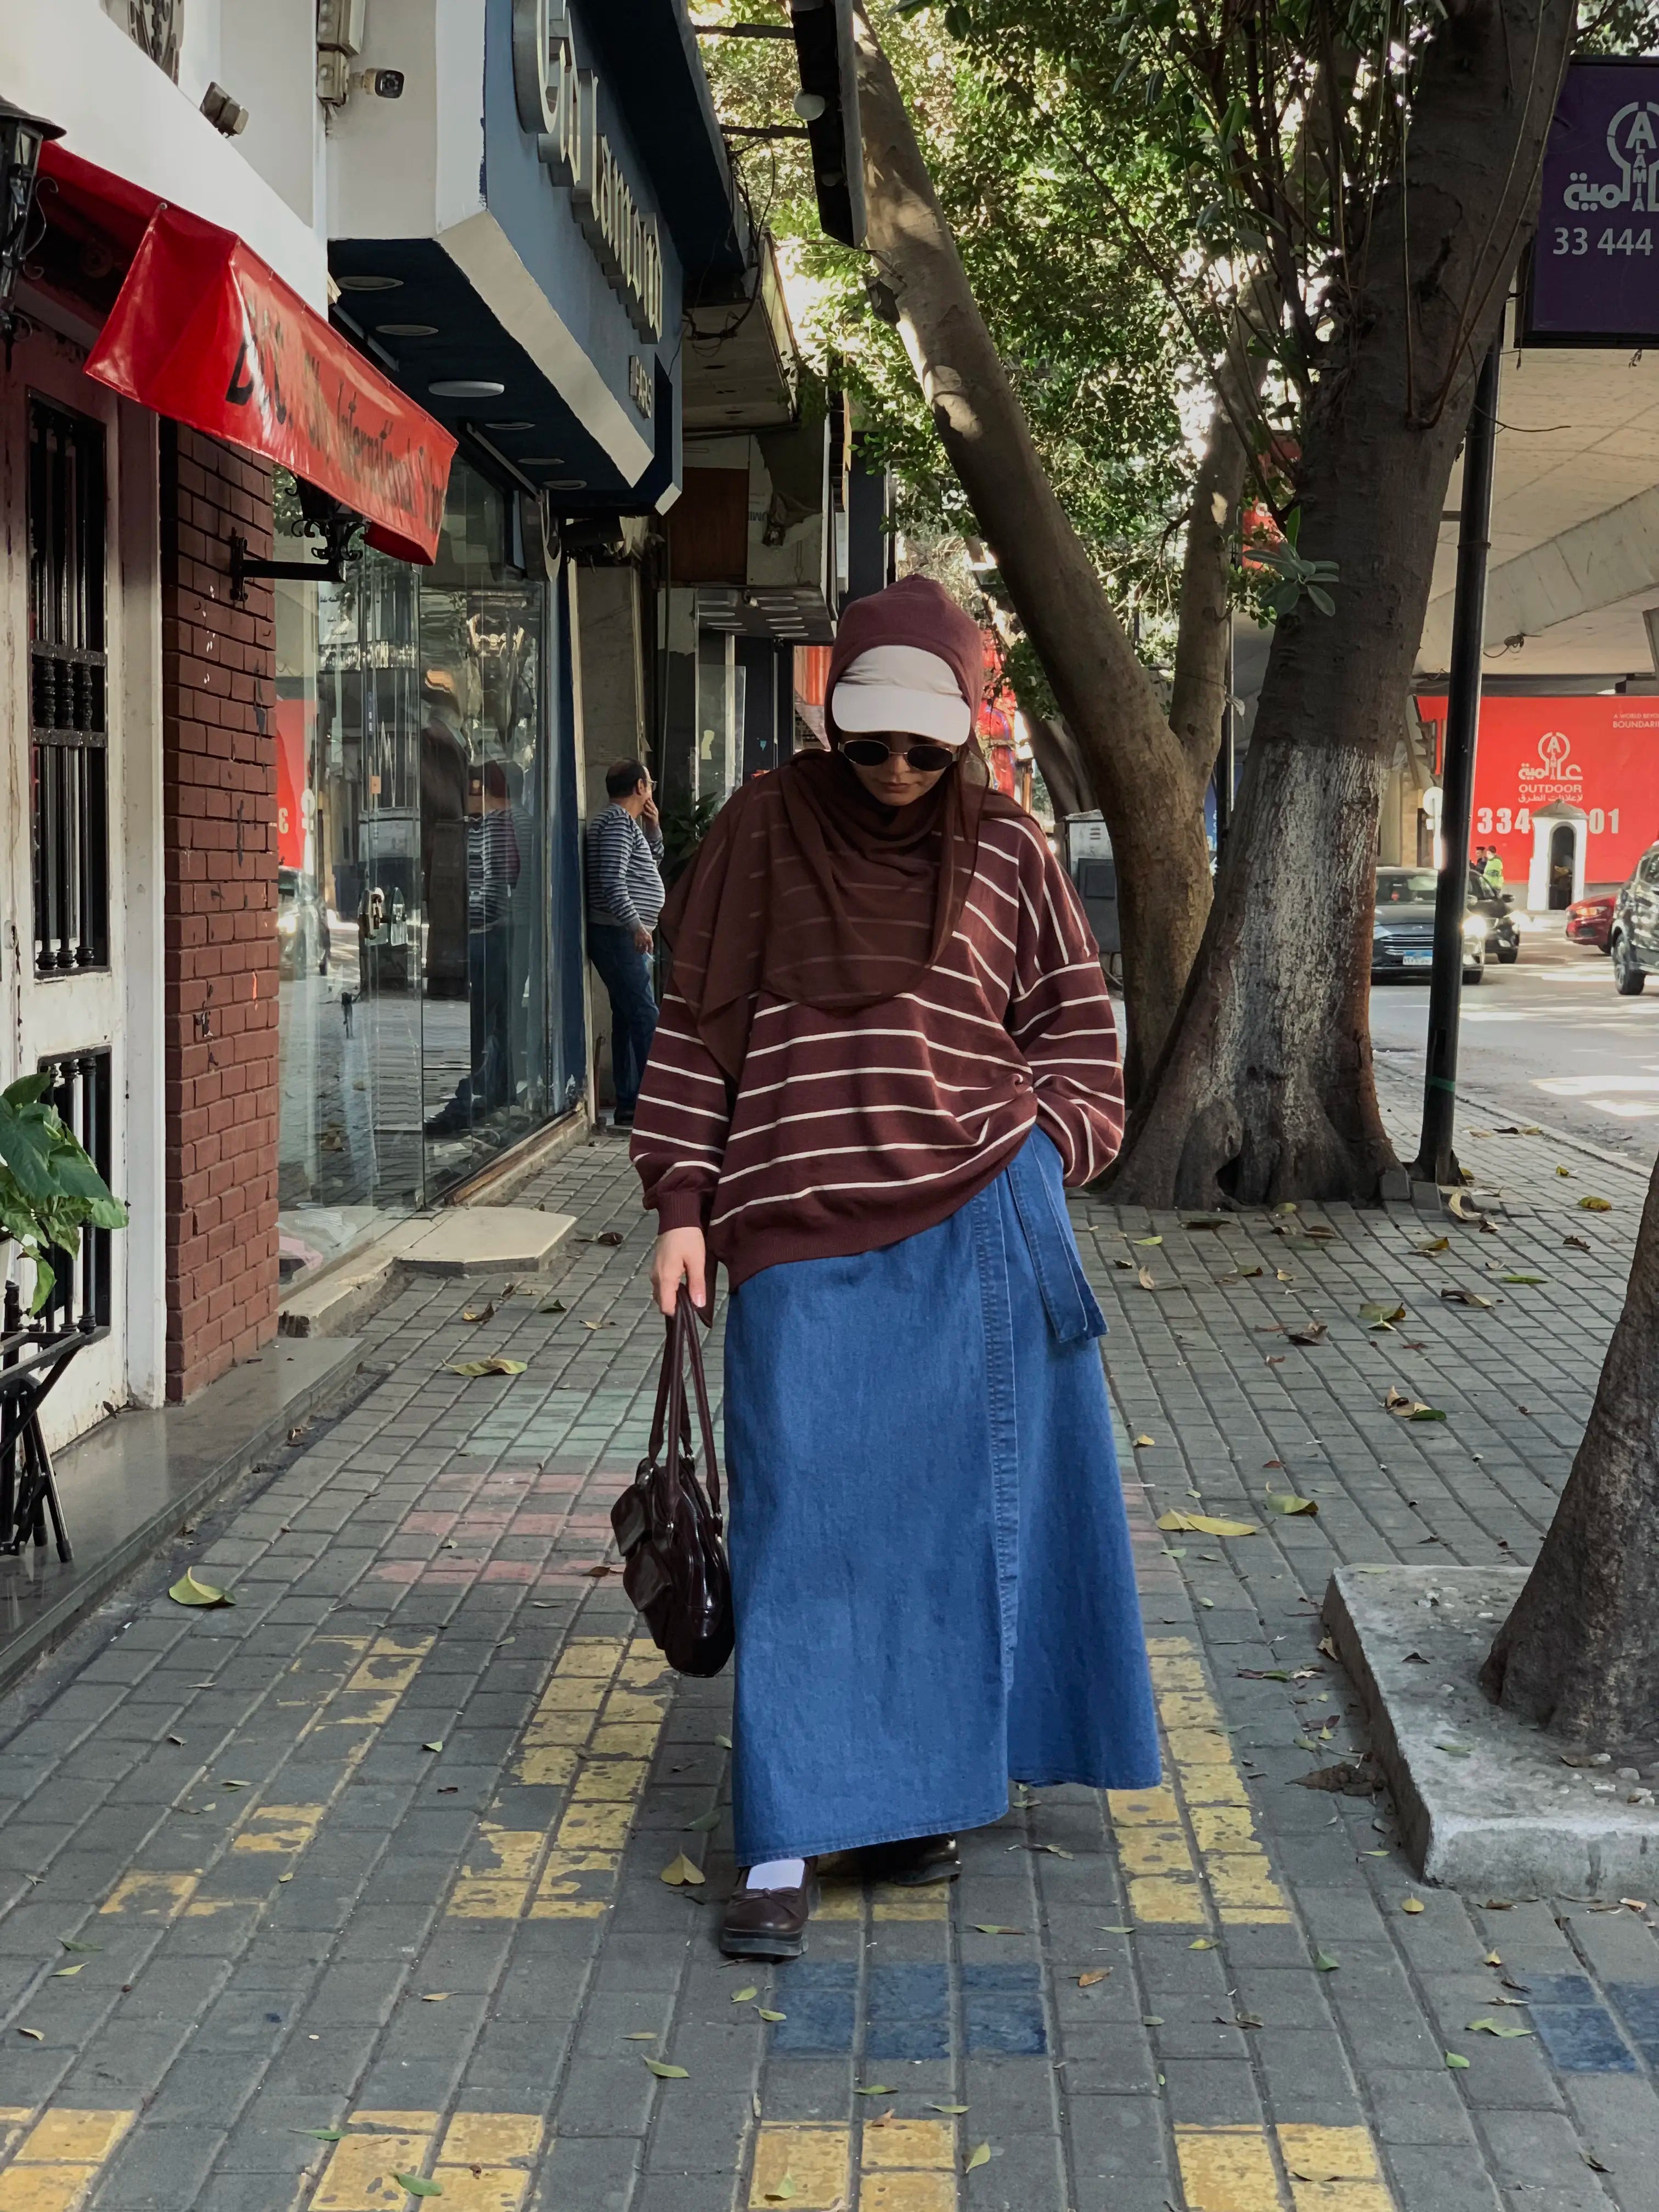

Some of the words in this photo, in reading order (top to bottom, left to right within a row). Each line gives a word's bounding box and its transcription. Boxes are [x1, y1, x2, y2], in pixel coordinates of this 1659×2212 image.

[1553, 227, 1588, 255] 33
[1597, 228, 1654, 256] 444
[1518, 784, 1582, 793] OUTDOOR
